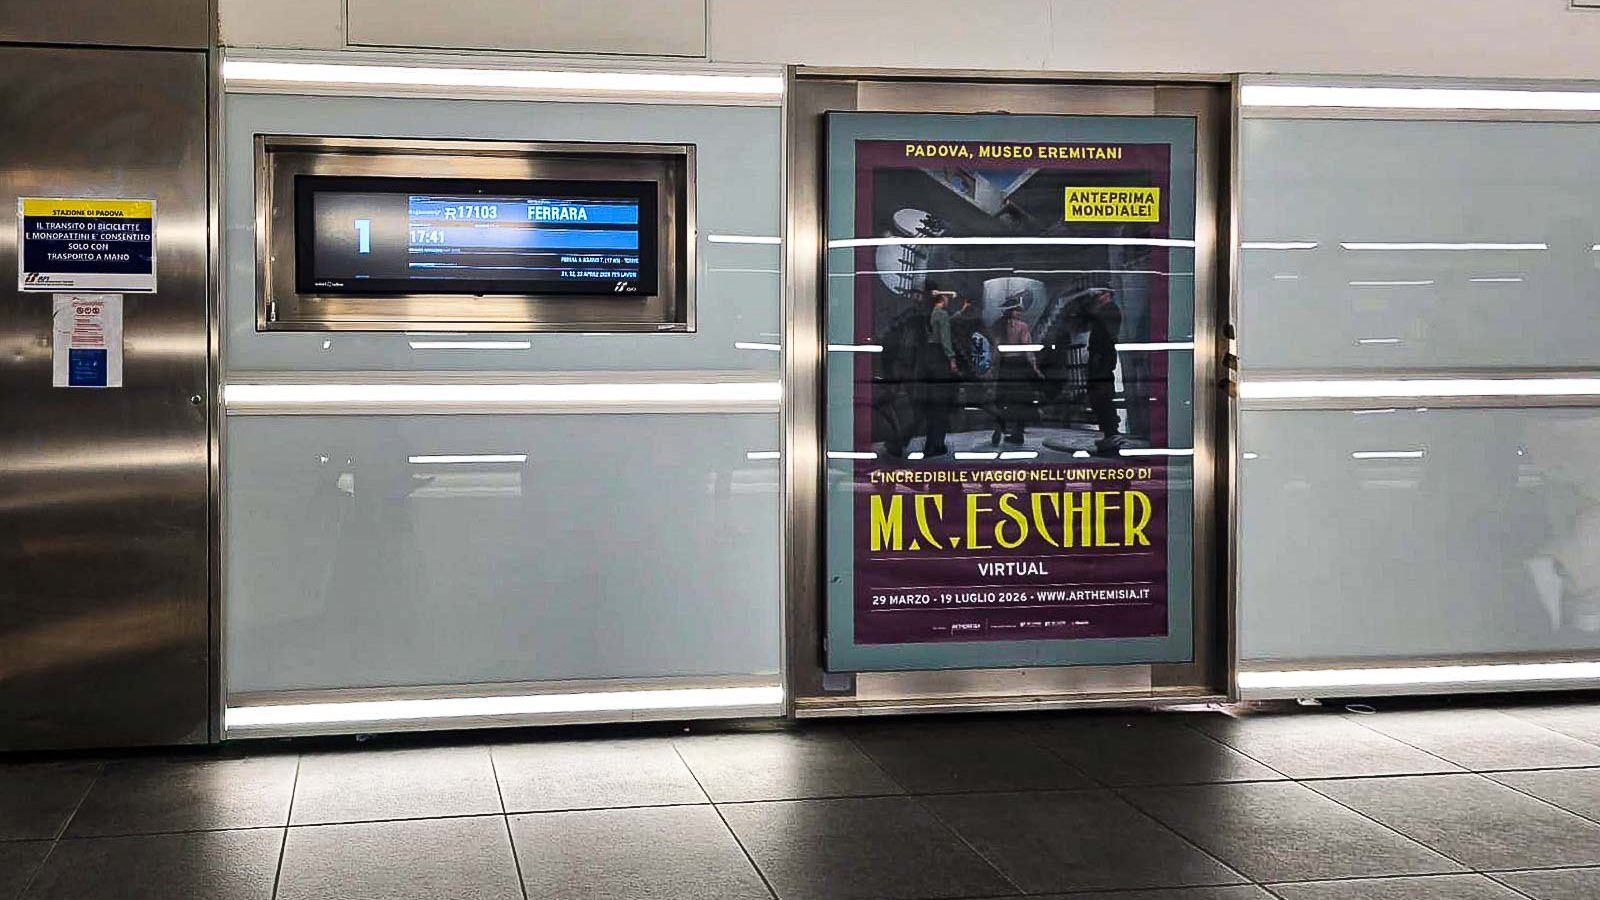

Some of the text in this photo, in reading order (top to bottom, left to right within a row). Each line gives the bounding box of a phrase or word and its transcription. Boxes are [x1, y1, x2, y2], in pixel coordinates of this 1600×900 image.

[905, 145, 1122, 159] PADOVA, MUSEO EREMITANI
[1069, 192, 1155, 216] ANTEPRIMA MONDIALE!
[458, 205, 497, 219] 17103
[527, 205, 588, 221] FERRARA
[36, 222, 44, 230] IL
[45, 222, 86, 230] TRANSITO
[97, 223, 140, 231] BICICLETTE
[26, 232, 31, 240] E
[32, 232, 90, 240] MONOPATTINI
[100, 233, 151, 241] CONSENTITO
[354, 219, 370, 252] 1
[410, 230, 445, 243] 17:41
[103, 253, 130, 261] MANO
[871, 468, 1151, 484] L'INCREDIBILE VIAGGIO NELL'UNIVERSO DI
[978, 562, 1048, 576] VIRTUAL
[872, 595, 887, 605] 29
[889, 594, 930, 605] MARZO
[940, 594, 953, 604] 19
[956, 593, 996, 604] LUGLIO
[998, 592, 1027, 603] 2026
[1037, 588, 1150, 601] WWW.ARTHEMISIA.IT
